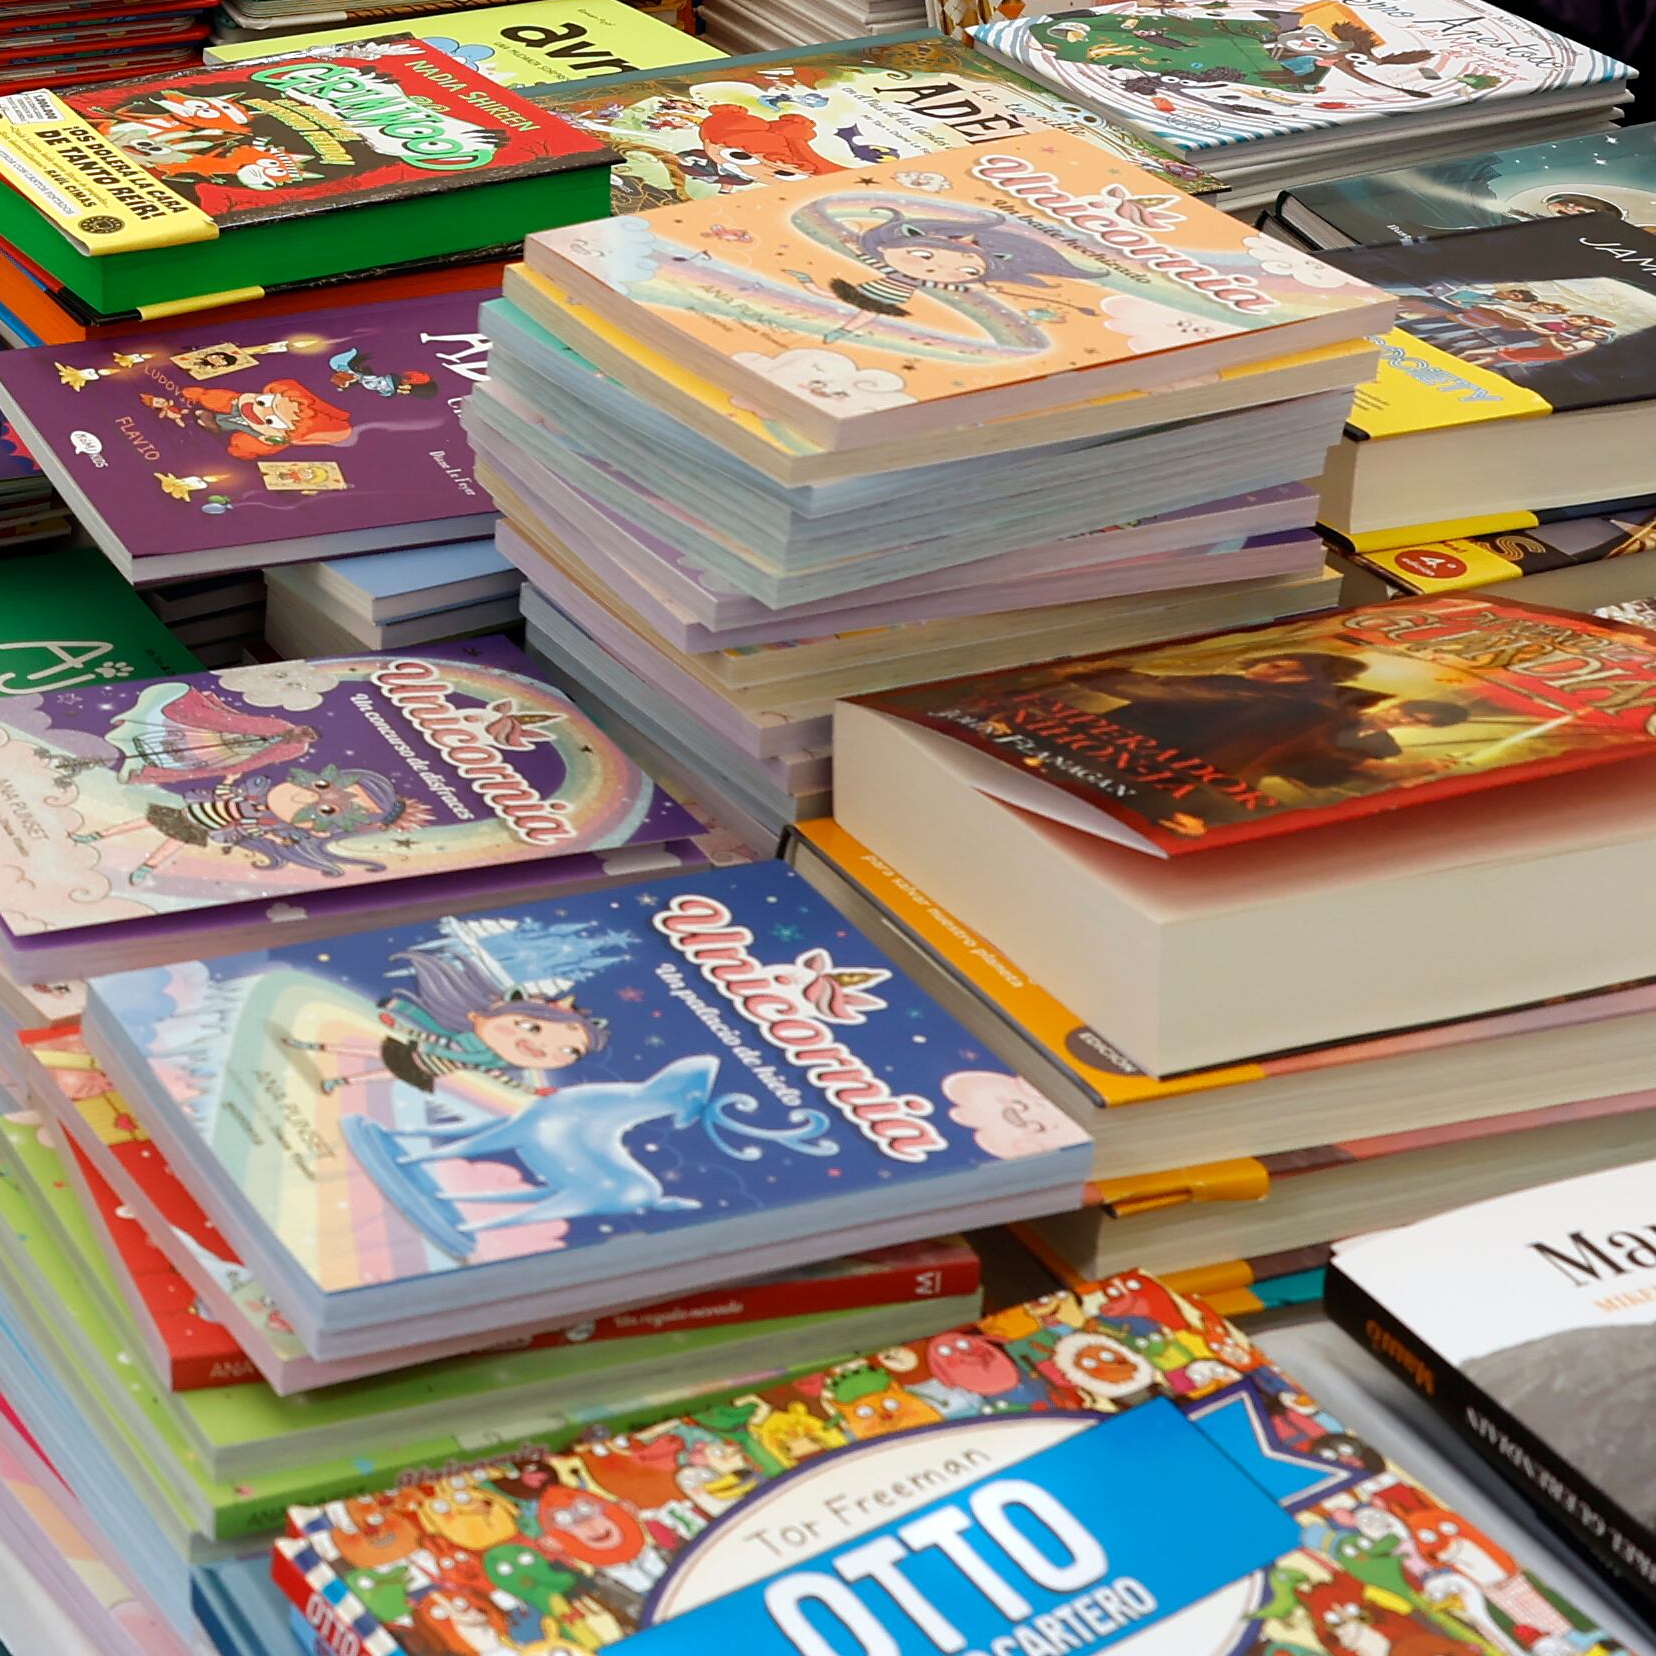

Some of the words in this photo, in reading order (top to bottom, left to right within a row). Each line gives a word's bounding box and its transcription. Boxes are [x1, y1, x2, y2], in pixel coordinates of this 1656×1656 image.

[405, 58, 469, 93] NADIA
[458, 89, 544, 133] SHIREEN
[35, 129, 70, 147] DE
[56, 146, 121, 185] TANTO
[107, 183, 169, 221] REÍR!
[45, 166, 73, 190] RAÚL
[64, 184, 97, 209] CIMAS
[62, 125, 93, 144] ¡OS
[85, 142, 146, 179] DOLERÁ
[129, 176, 156, 189] LA
[146, 186, 191, 215] CARA
[974, 155, 1280, 314] Unicornia
[990, 197, 1018, 216] Un
[1017, 213, 1057, 240] baile
[1056, 233, 1152, 285] hechizado
[115, 416, 162, 462] FLAVIO
[350, 693, 371, 715] Un
[364, 710, 414, 760] concurso
[406, 751, 432, 774] de
[420, 769, 476, 821] disfraces
[371, 660, 578, 845] Unicornia
[861, 854, 894, 877] para
[892, 876, 932, 908] salvar
[927, 904, 978, 949] nuestro
[968, 946, 1025, 989] planeta
[653, 894, 948, 1163] Unicornia
[655, 962, 687, 997] Un
[677, 987, 744, 1049] palacio
[732, 1043, 763, 1068] de
[752, 1063, 803, 1108] hielo
[745, 1518, 819, 1560] Tor
[825, 1447, 993, 1529] Freeman
[764, 1479, 1109, 1656] OTTO
[991, 1575, 1159, 1656] CARTERO
